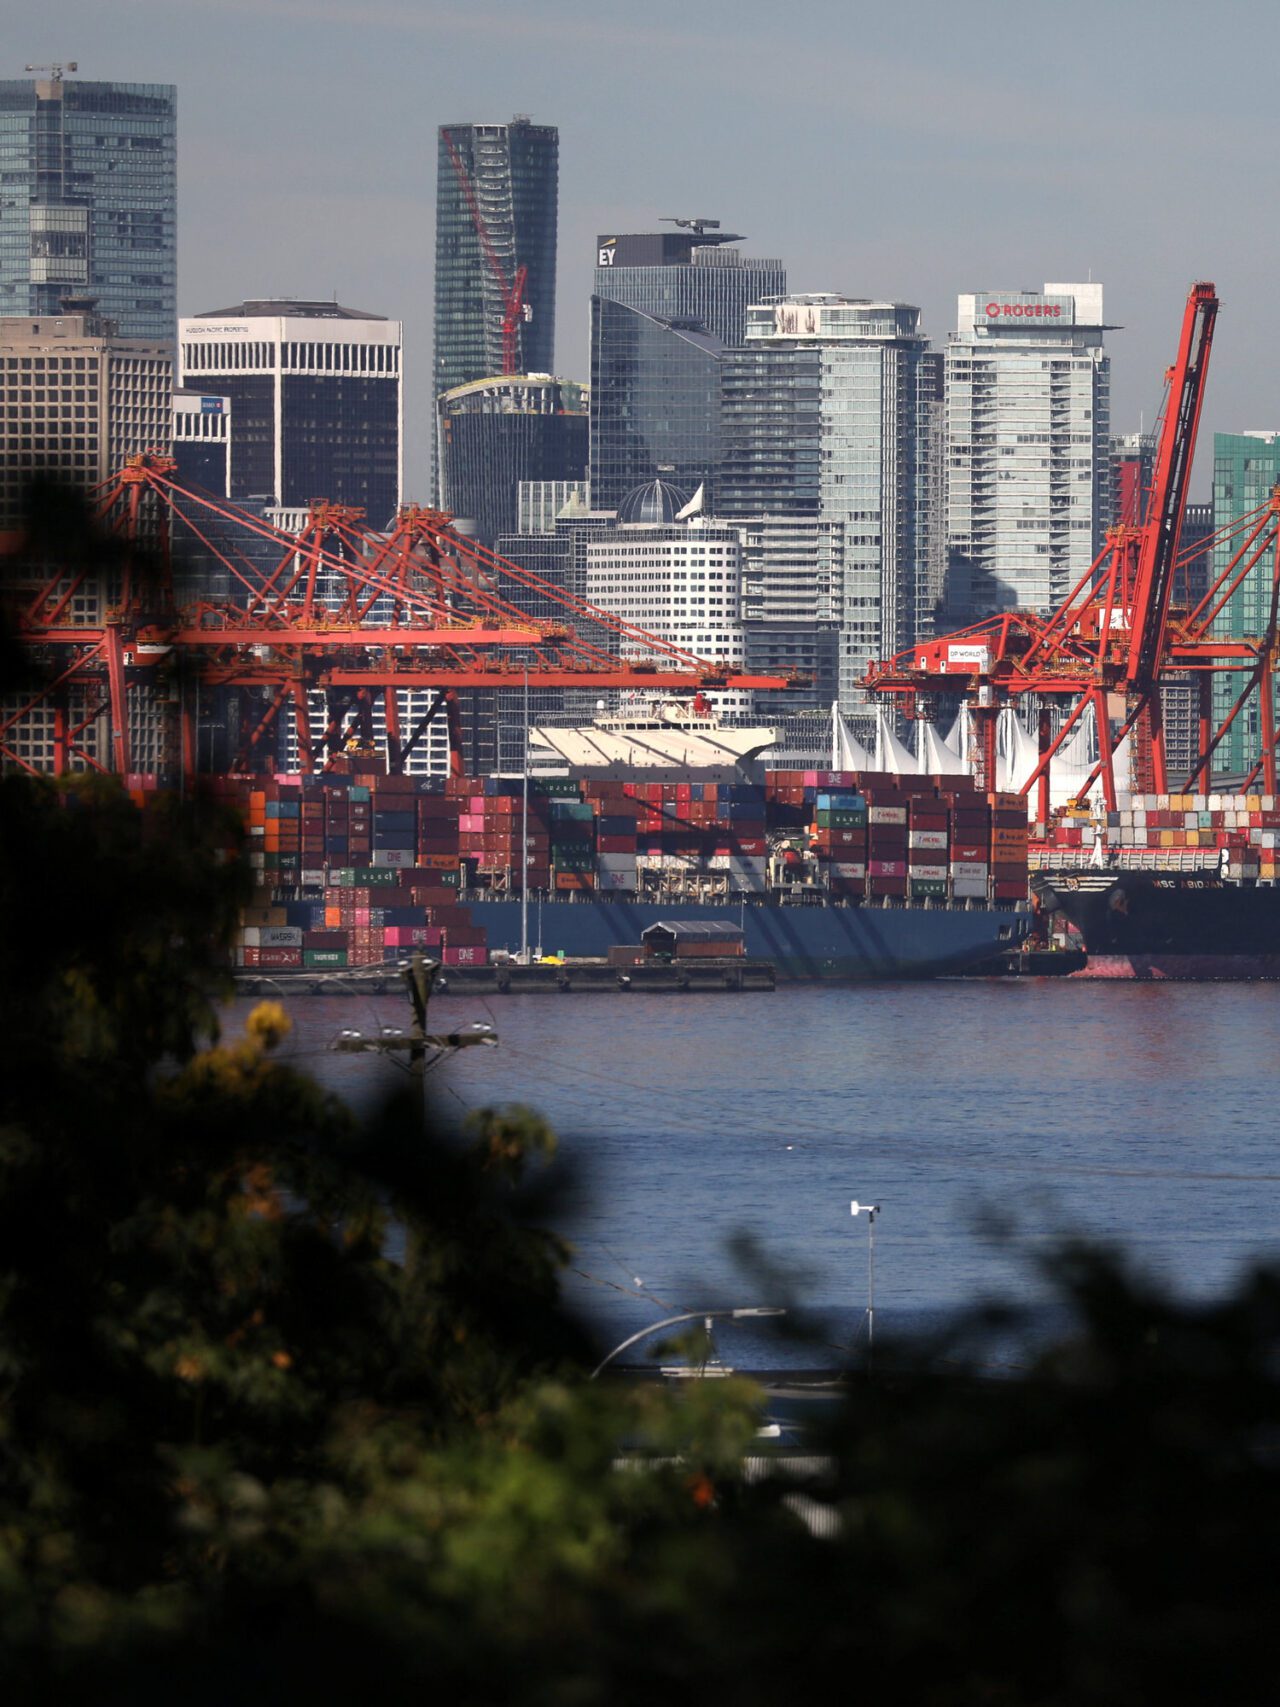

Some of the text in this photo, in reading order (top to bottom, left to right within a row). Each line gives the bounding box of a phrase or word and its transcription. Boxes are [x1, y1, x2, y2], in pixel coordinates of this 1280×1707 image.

[599, 249, 616, 266] EY
[1002, 304, 1061, 317] ROGERS
[1153, 880, 1176, 888] MSC
